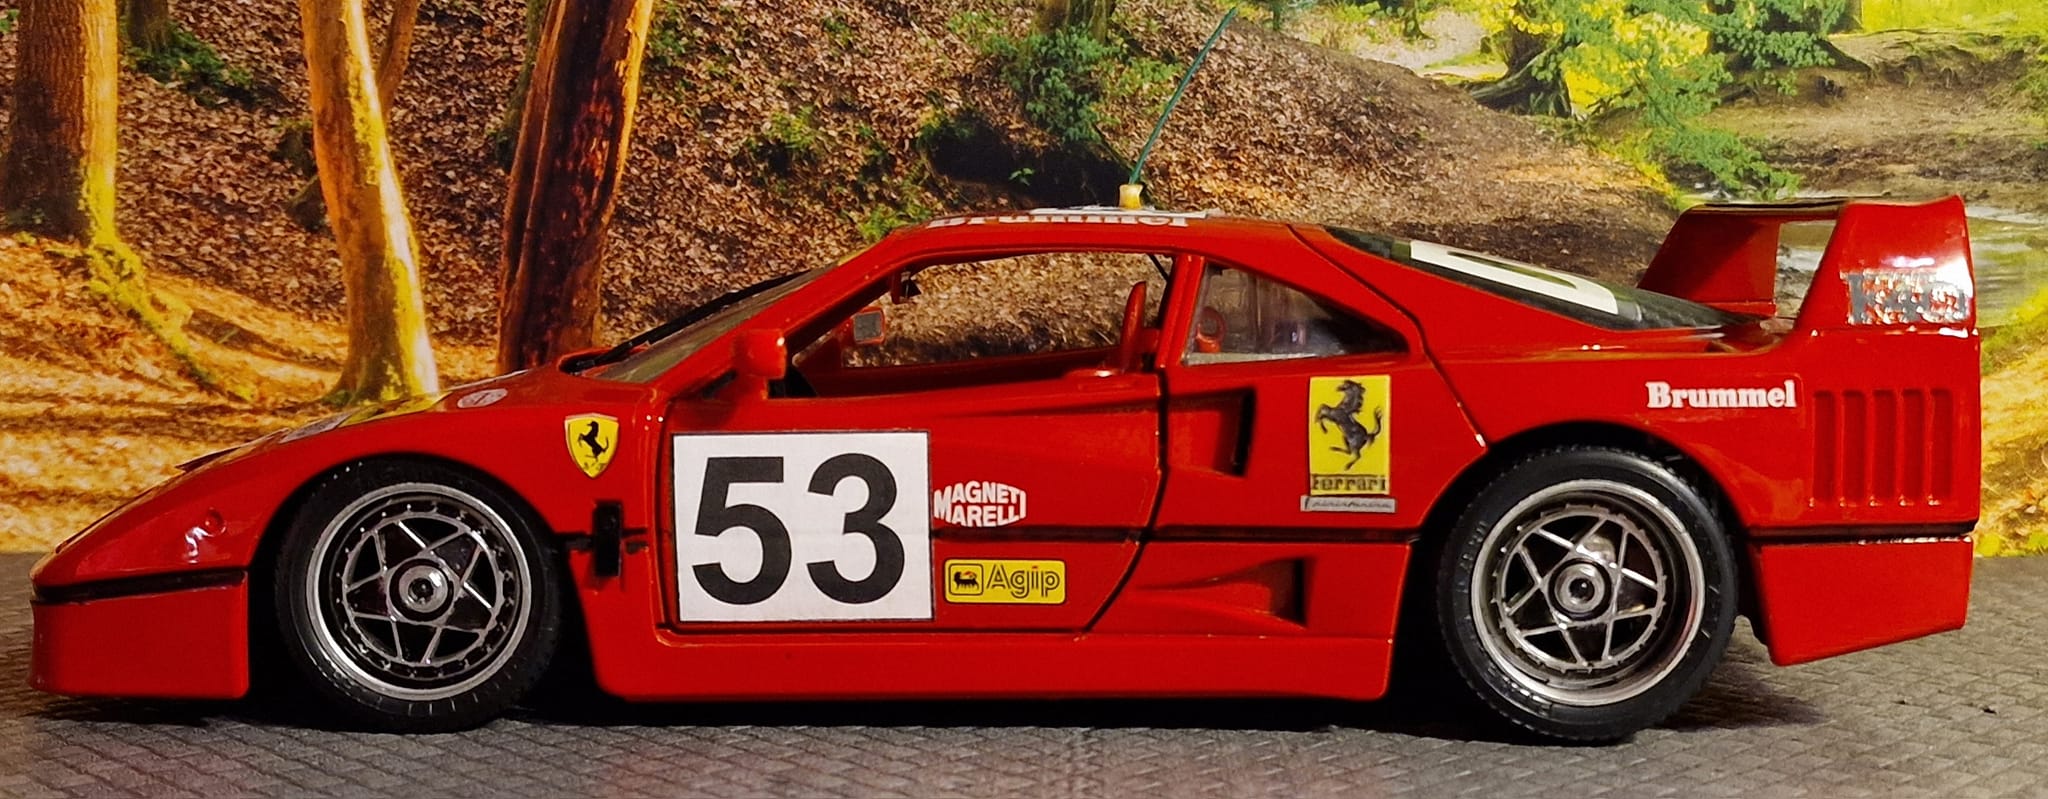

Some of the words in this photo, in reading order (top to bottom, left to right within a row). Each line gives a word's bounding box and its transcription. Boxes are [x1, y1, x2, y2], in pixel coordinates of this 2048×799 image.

[1646, 379, 1797, 409] Brummel
[933, 480, 1027, 509] MAGNETI
[1311, 474, 1387, 491] Ferrari
[933, 499, 1027, 528] MARELLI
[691, 452, 905, 605] 53
[985, 563, 1061, 599] Agip
